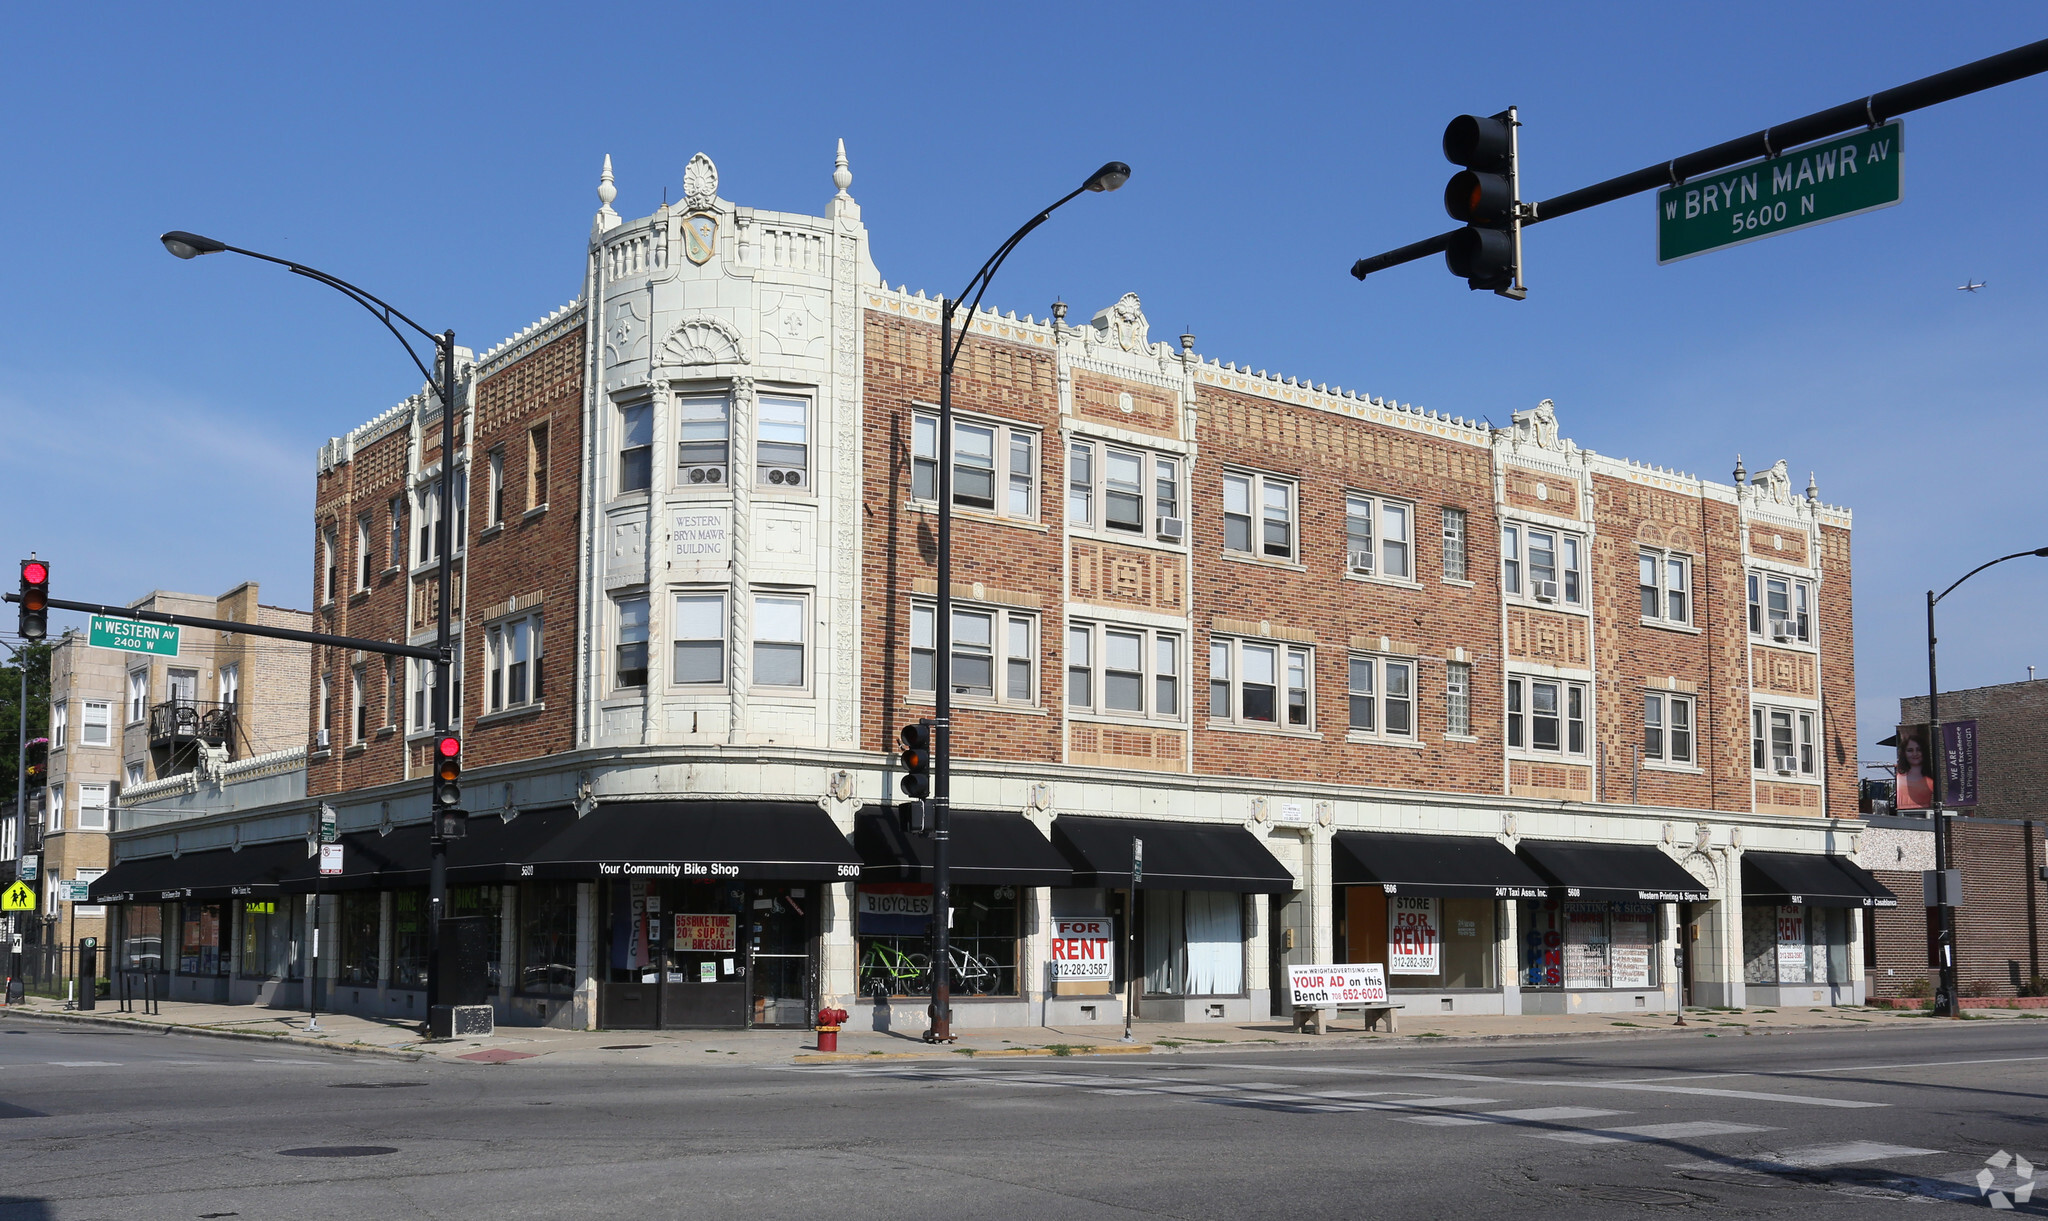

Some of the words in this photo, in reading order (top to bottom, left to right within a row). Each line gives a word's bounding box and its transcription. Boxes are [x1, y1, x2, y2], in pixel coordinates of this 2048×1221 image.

[1666, 200, 1678, 220] W
[1686, 172, 1758, 220] BRYN
[1773, 145, 1857, 196] MAWR
[1867, 139, 1890, 164] AV
[1732, 202, 1787, 234] 5600
[1801, 194, 1814, 216] N
[676, 516, 720, 526] WESTERN
[674, 530, 696, 541] BRYN
[698, 530, 725, 540] MAWR
[677, 543, 720, 554] BUILDING
[95, 622, 102, 630] N
[106, 621, 159, 639] WESTERN
[162, 631, 175, 639] AV
[114, 637, 140, 648] 2400
[146, 641, 154, 650] W
[1949, 750, 1957, 766] ARE
[1951, 768, 1958, 780] WE
[600, 863, 620, 874] Your
[624, 863, 680, 877] Community
[684, 864, 707, 875] Bike
[711, 864, 739, 877] Shop
[838, 865, 860, 876] 5600
[456, 888, 478, 908] BIKE
[1495, 888, 1507, 896] 24/7
[1508, 888, 1519, 896] Taxi
[1521, 888, 1536, 897] Assn.
[1537, 889, 1547, 897] Inc.
[1568, 888, 1580, 897] 5608
[1639, 891, 1659, 899] Western
[1660, 892, 1678, 902] Printing
[1684, 892, 1699, 902] Signs,
[398, 891, 416, 911] BIKE
[869, 896, 928, 912] BICYCLES
[1397, 898, 1429, 909] STORE
[1563, 903, 1608, 912] PRINTING
[1625, 904, 1652, 913] SIGNS
[711, 916, 730, 927] TUNE
[1398, 913, 1428, 926] FOR
[677, 928, 692, 938] 20%
[1060, 923, 1100, 933] FOR
[1778, 918, 1802, 940] RENT
[1393, 928, 1435, 955] RENT
[1052, 938, 1108, 960] RENT
[1394, 957, 1433, 968] 312-282-3587
[1054, 964, 1107, 975] 312-282-3587
[1293, 976, 1324, 988] YOUR
[1330, 976, 1344, 987] AD
[1350, 978, 1360, 986] on
[1365, 976, 1382, 986] this
[1294, 990, 1328, 1001] Bench
[1343, 988, 1383, 1000] 652-6020
